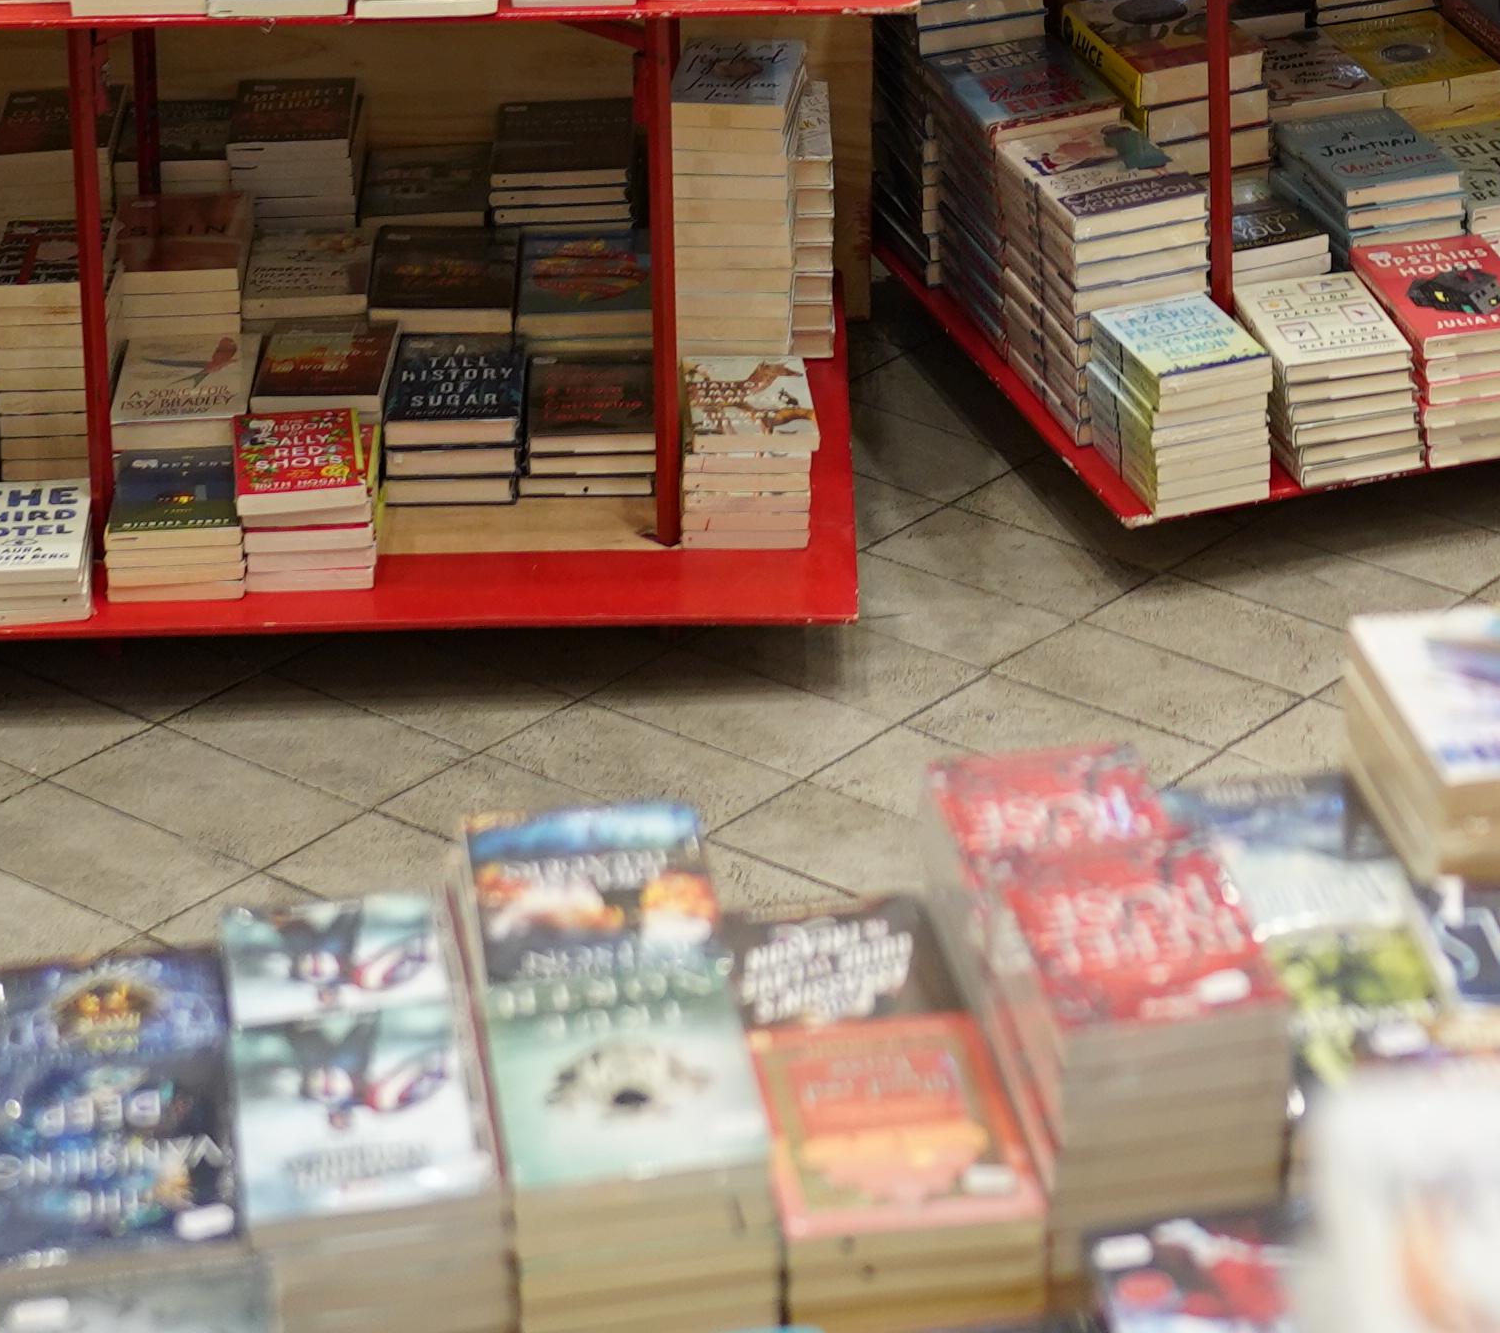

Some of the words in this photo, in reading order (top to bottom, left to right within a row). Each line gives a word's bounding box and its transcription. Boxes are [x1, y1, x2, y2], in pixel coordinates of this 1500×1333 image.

[1398, 259, 1484, 278] HOUSE
[1436, 315, 1487, 330] JULIA
[429, 356, 490, 368] TALL
[401, 367, 514, 383] HISTORY
[410, 393, 499, 407] SUGAR
